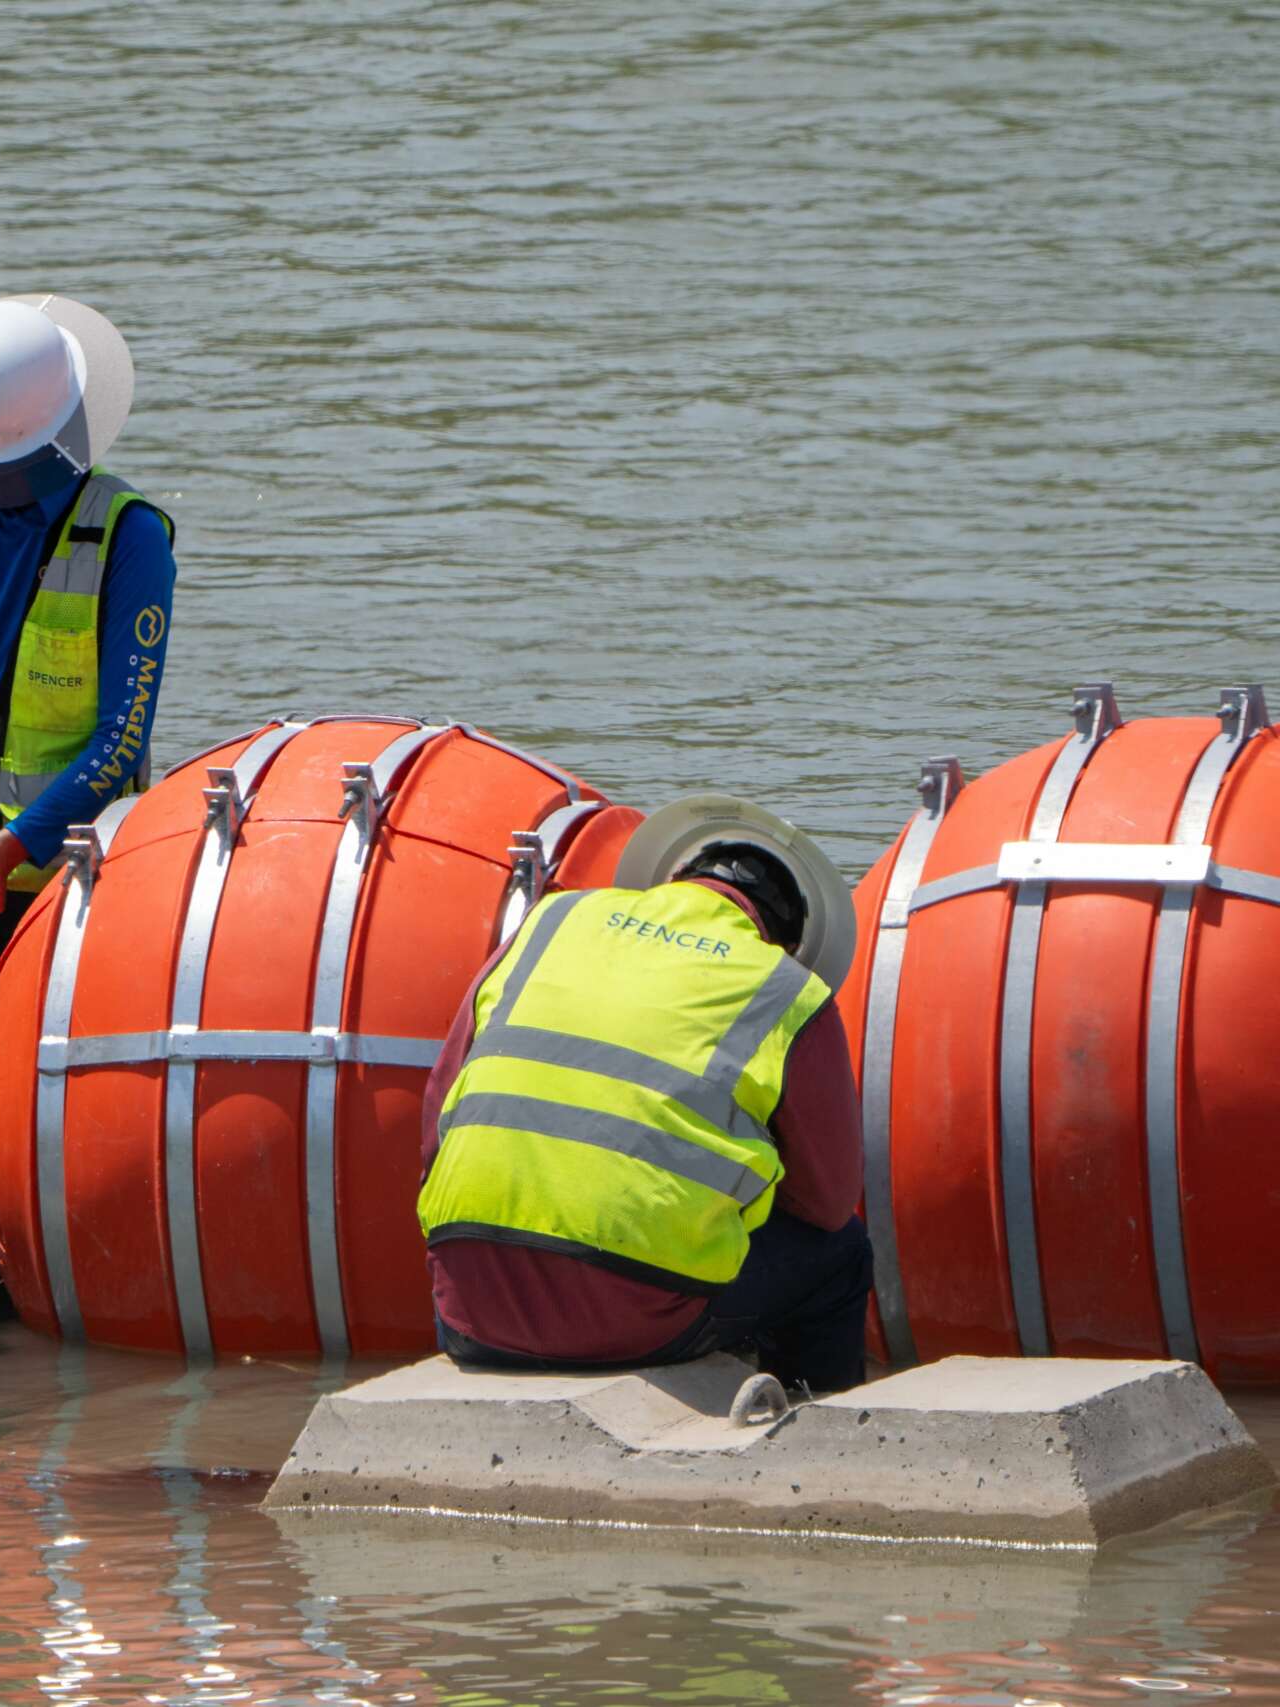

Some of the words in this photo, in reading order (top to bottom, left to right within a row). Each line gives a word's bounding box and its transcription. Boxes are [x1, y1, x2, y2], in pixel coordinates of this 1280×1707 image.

[28, 669, 83, 688] SPENCER
[88, 656, 158, 798] MAGELLAN
[607, 912, 731, 959] SPENCER
